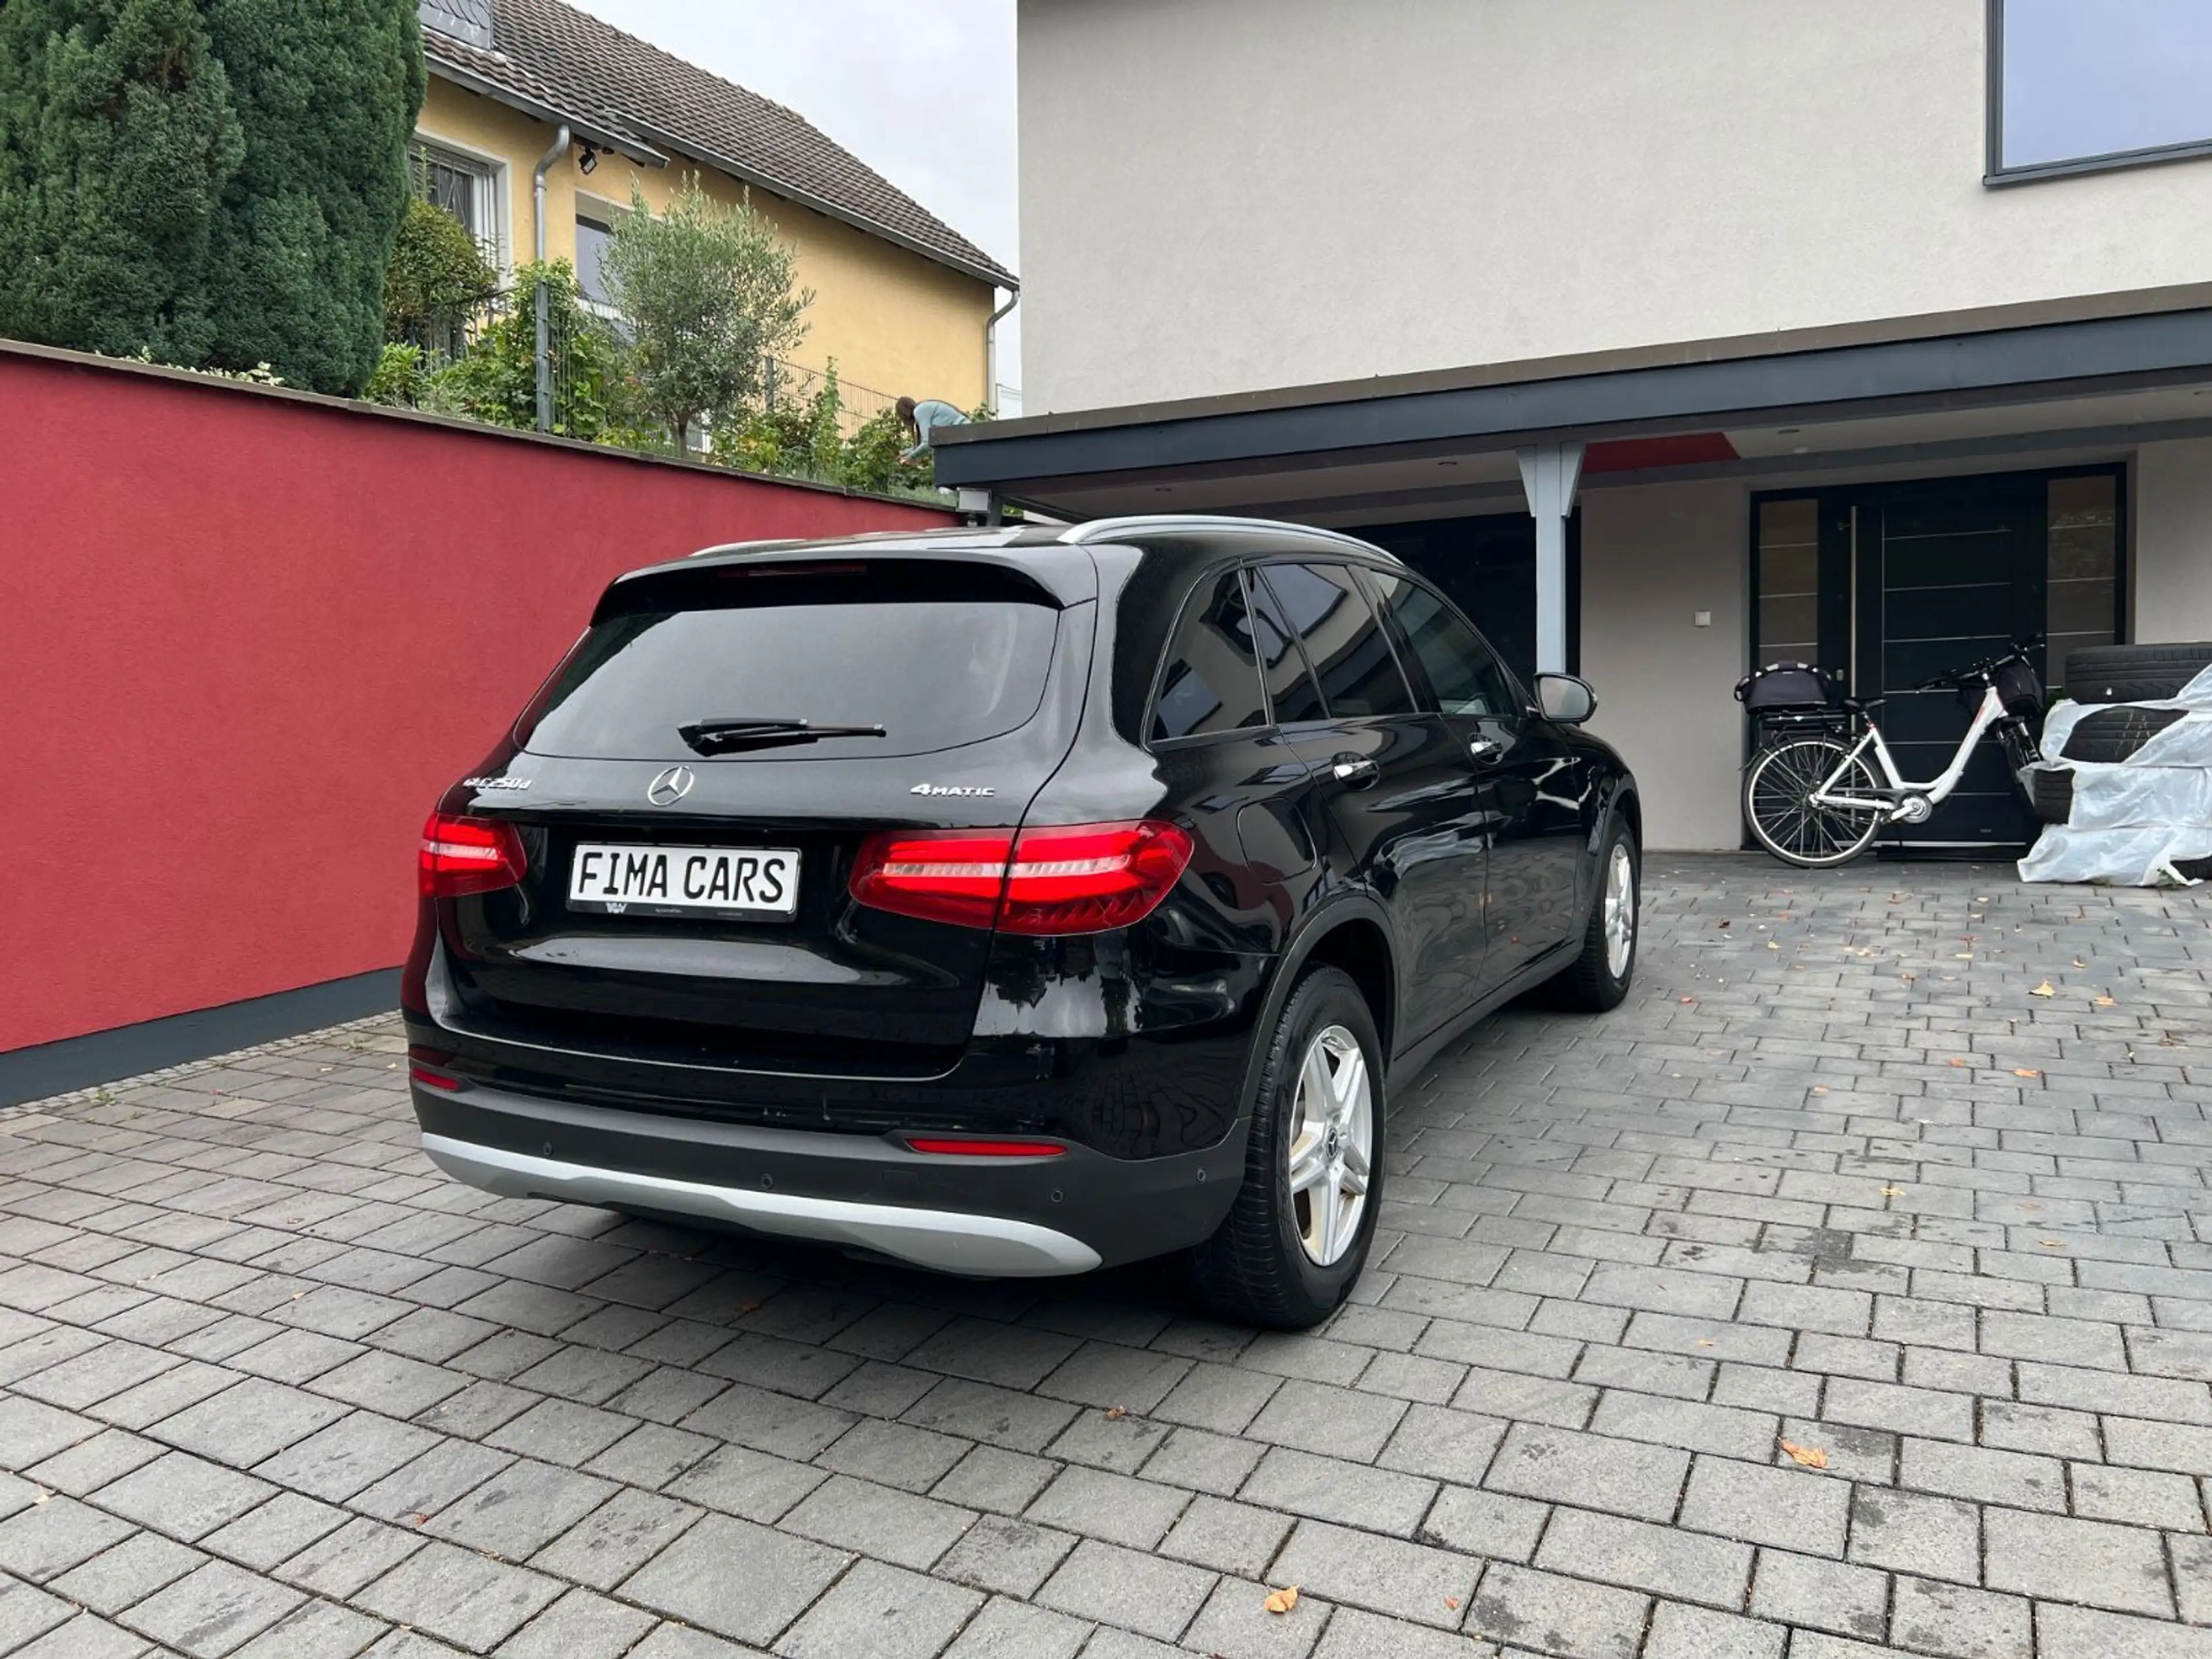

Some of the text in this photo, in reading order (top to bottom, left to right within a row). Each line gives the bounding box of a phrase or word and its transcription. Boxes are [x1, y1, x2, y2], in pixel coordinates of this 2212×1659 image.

[910, 783, 995, 796] 4MATIC
[578, 851, 785, 903] FIMA CARS
